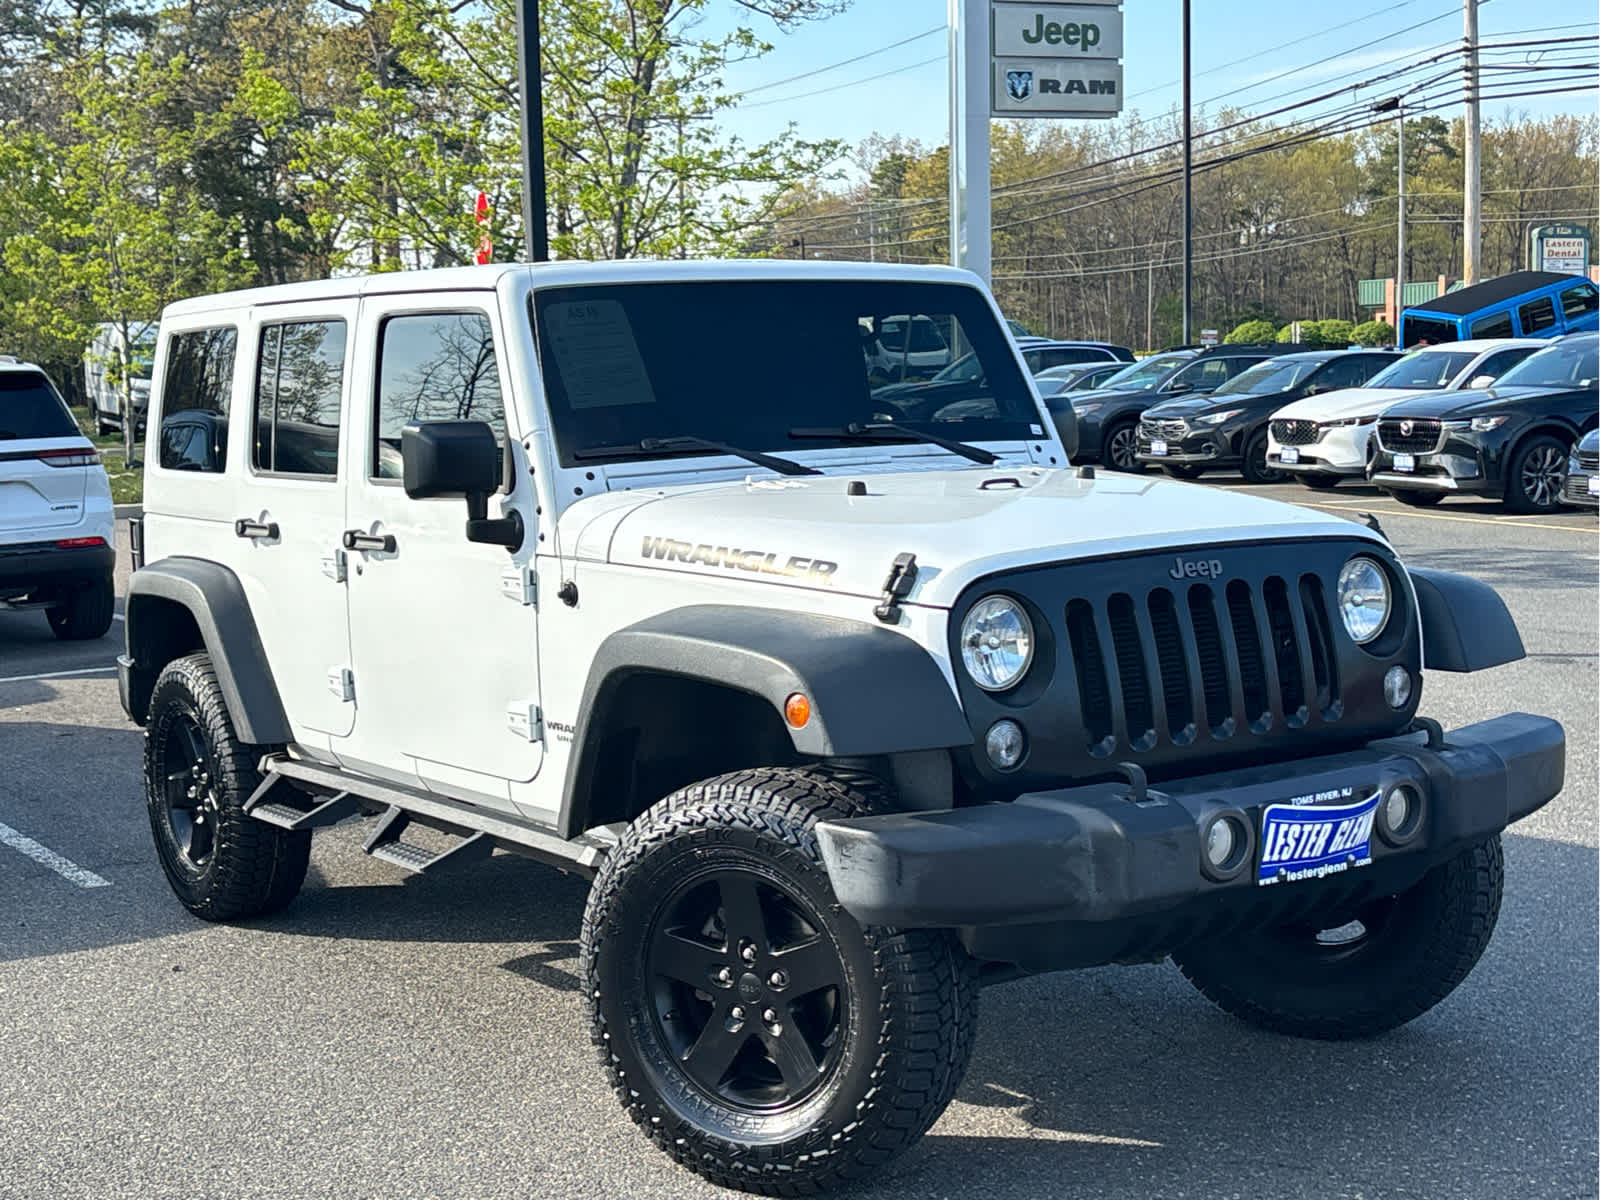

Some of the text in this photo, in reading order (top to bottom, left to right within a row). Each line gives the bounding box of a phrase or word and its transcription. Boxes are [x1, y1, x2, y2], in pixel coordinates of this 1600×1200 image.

[1022, 14, 1100, 52] Jeep
[1039, 79, 1116, 95] RAM
[1545, 239, 1583, 248] Eastern
[1547, 248, 1581, 257] Dental
[640, 535, 839, 586] WRANGLER
[1169, 556, 1223, 579] Jeep
[1291, 794, 1314, 805] TOMS
[1341, 786, 1353, 797] NJ
[1261, 822, 1333, 863] LESTER
